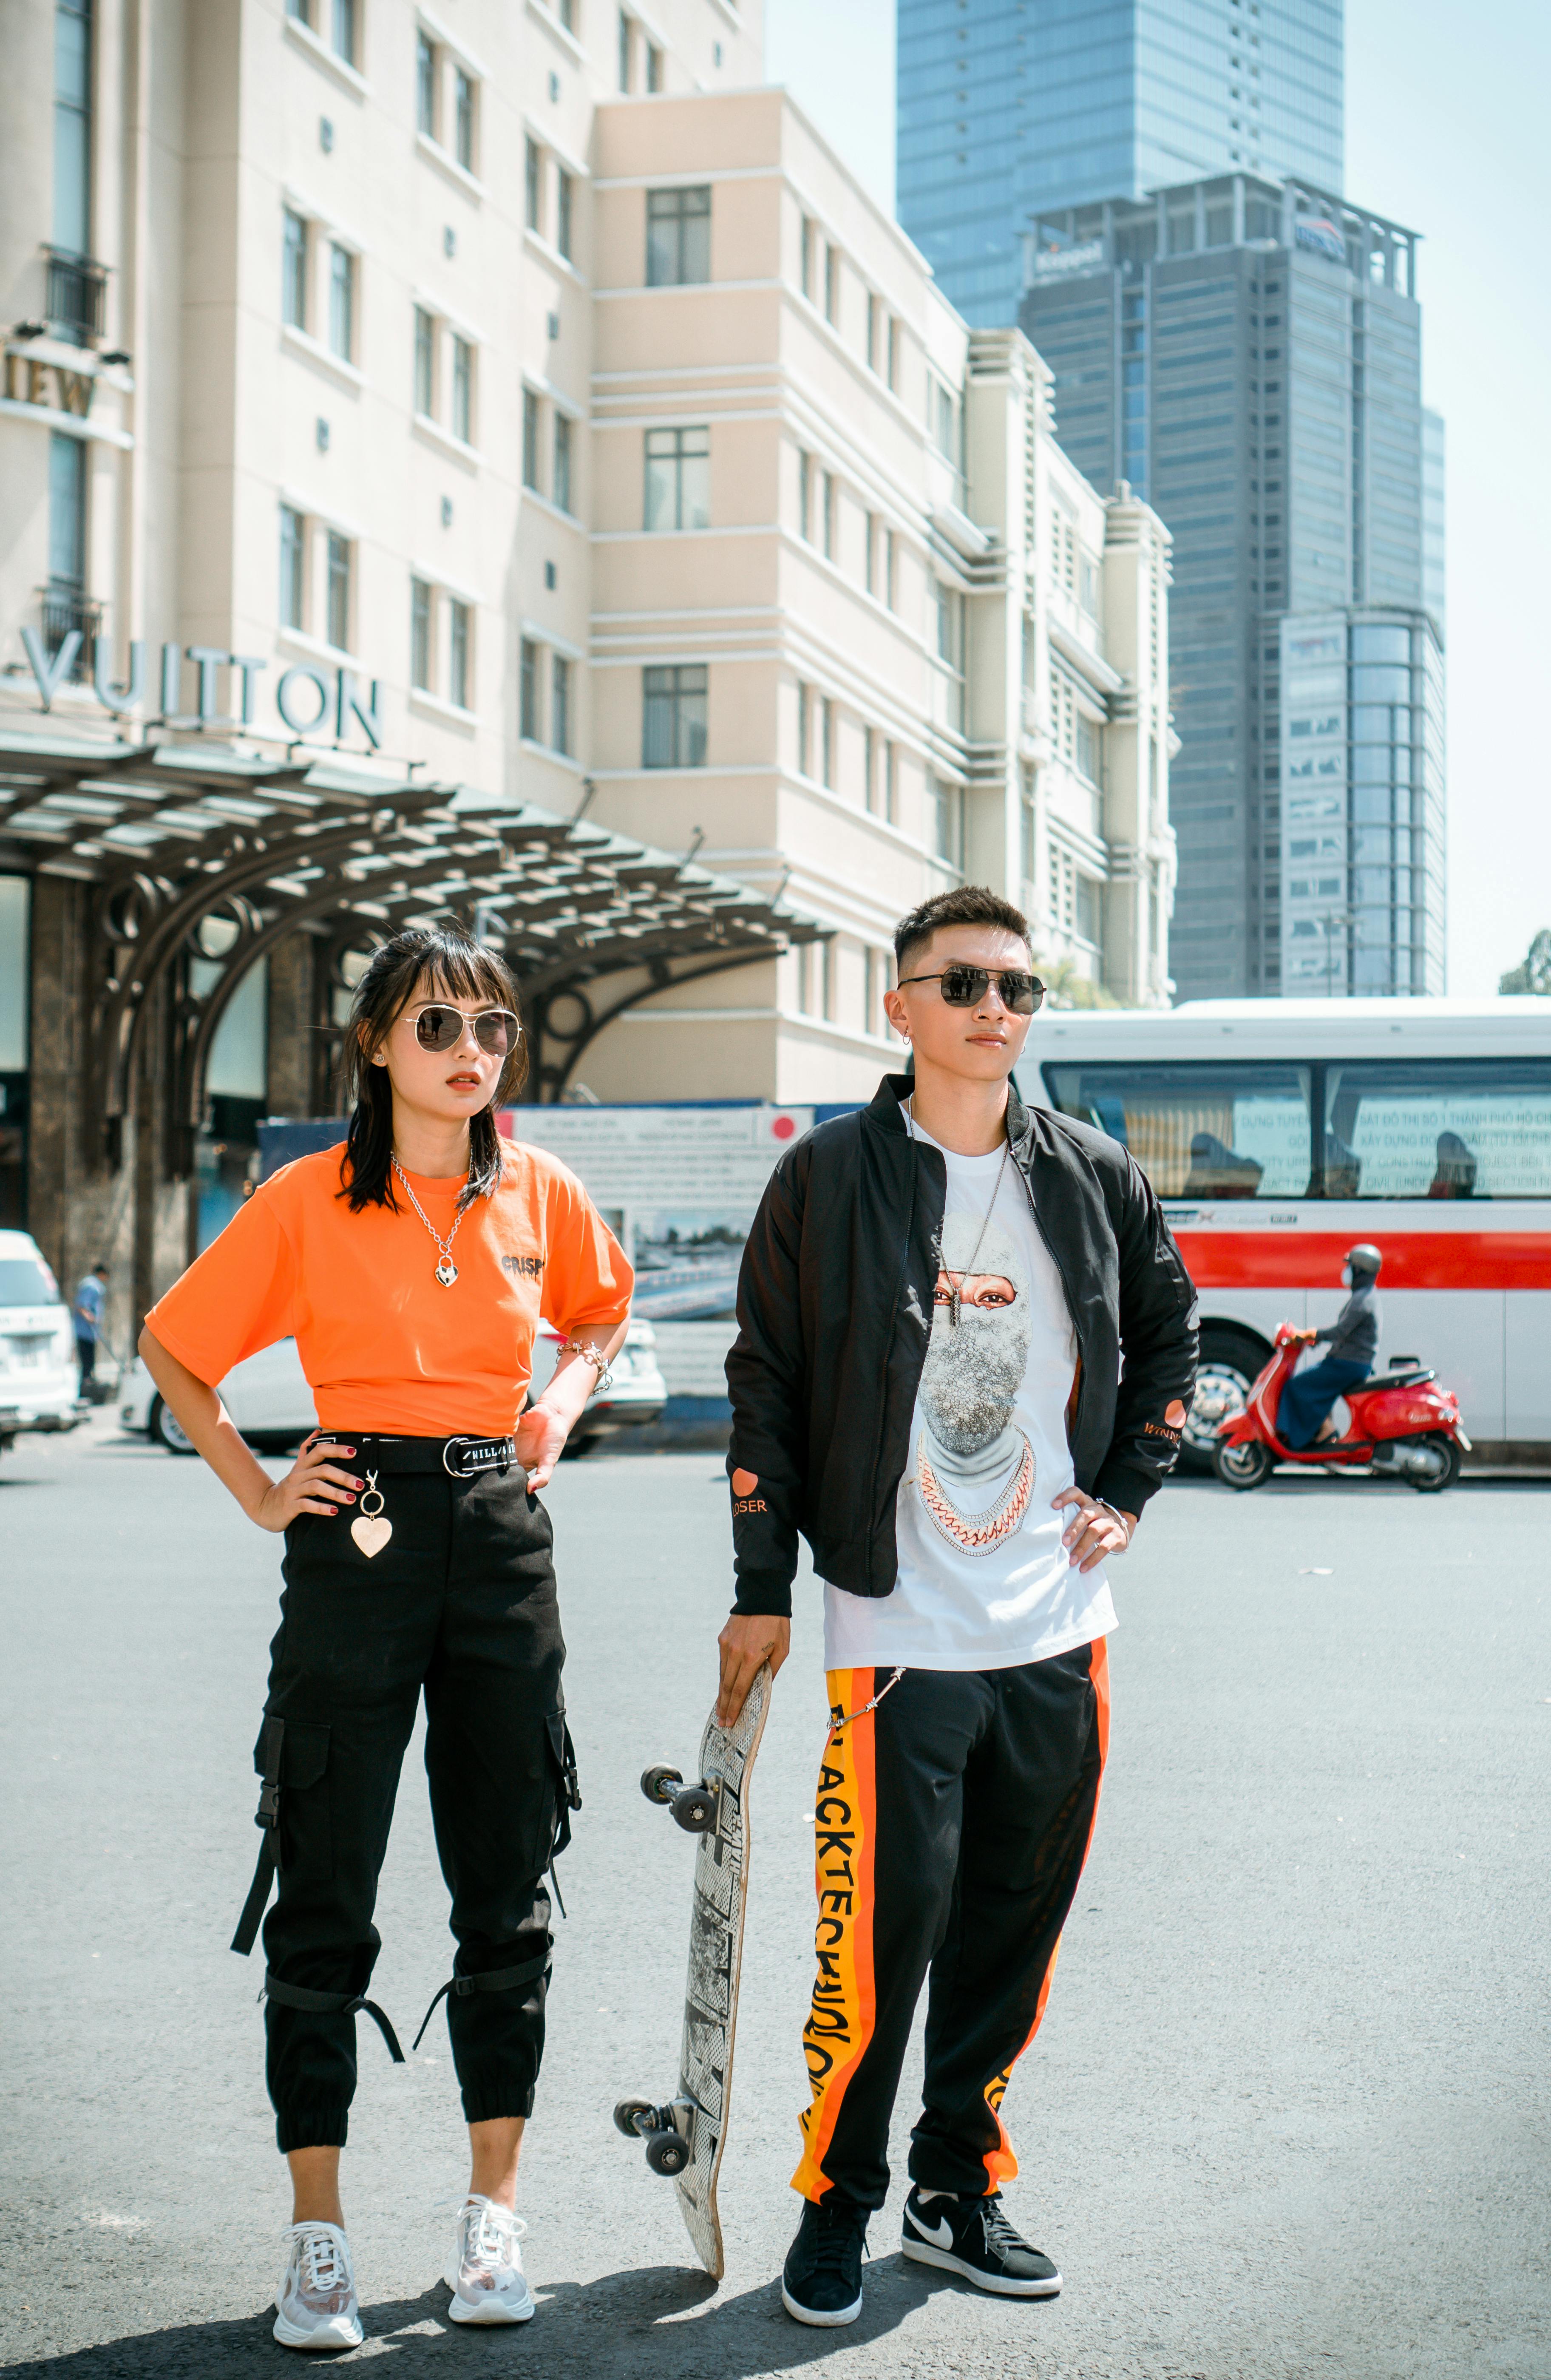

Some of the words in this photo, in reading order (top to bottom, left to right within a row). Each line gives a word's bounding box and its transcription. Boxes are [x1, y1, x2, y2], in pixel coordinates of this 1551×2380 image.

[20, 627, 384, 749] VUITTON
[732, 1500, 768, 1517] LOSER
[729, 1814, 743, 1875] HAWK
